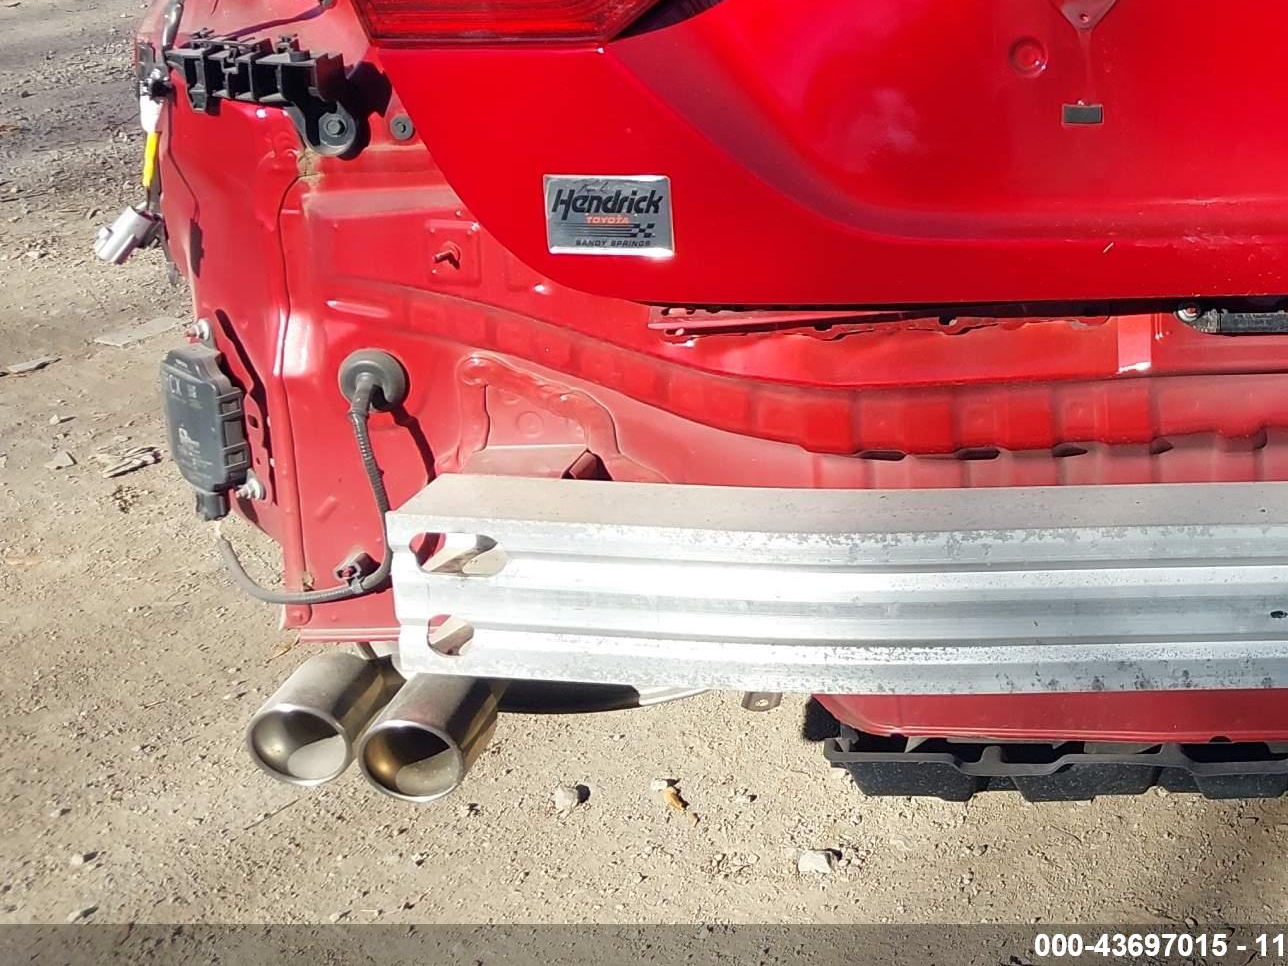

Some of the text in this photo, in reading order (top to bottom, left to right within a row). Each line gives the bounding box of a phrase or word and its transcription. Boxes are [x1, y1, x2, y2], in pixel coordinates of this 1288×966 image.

[552, 189, 663, 220] Hendrick
[586, 216, 630, 224] TOYOTA
[168, 374, 182, 396] CX
